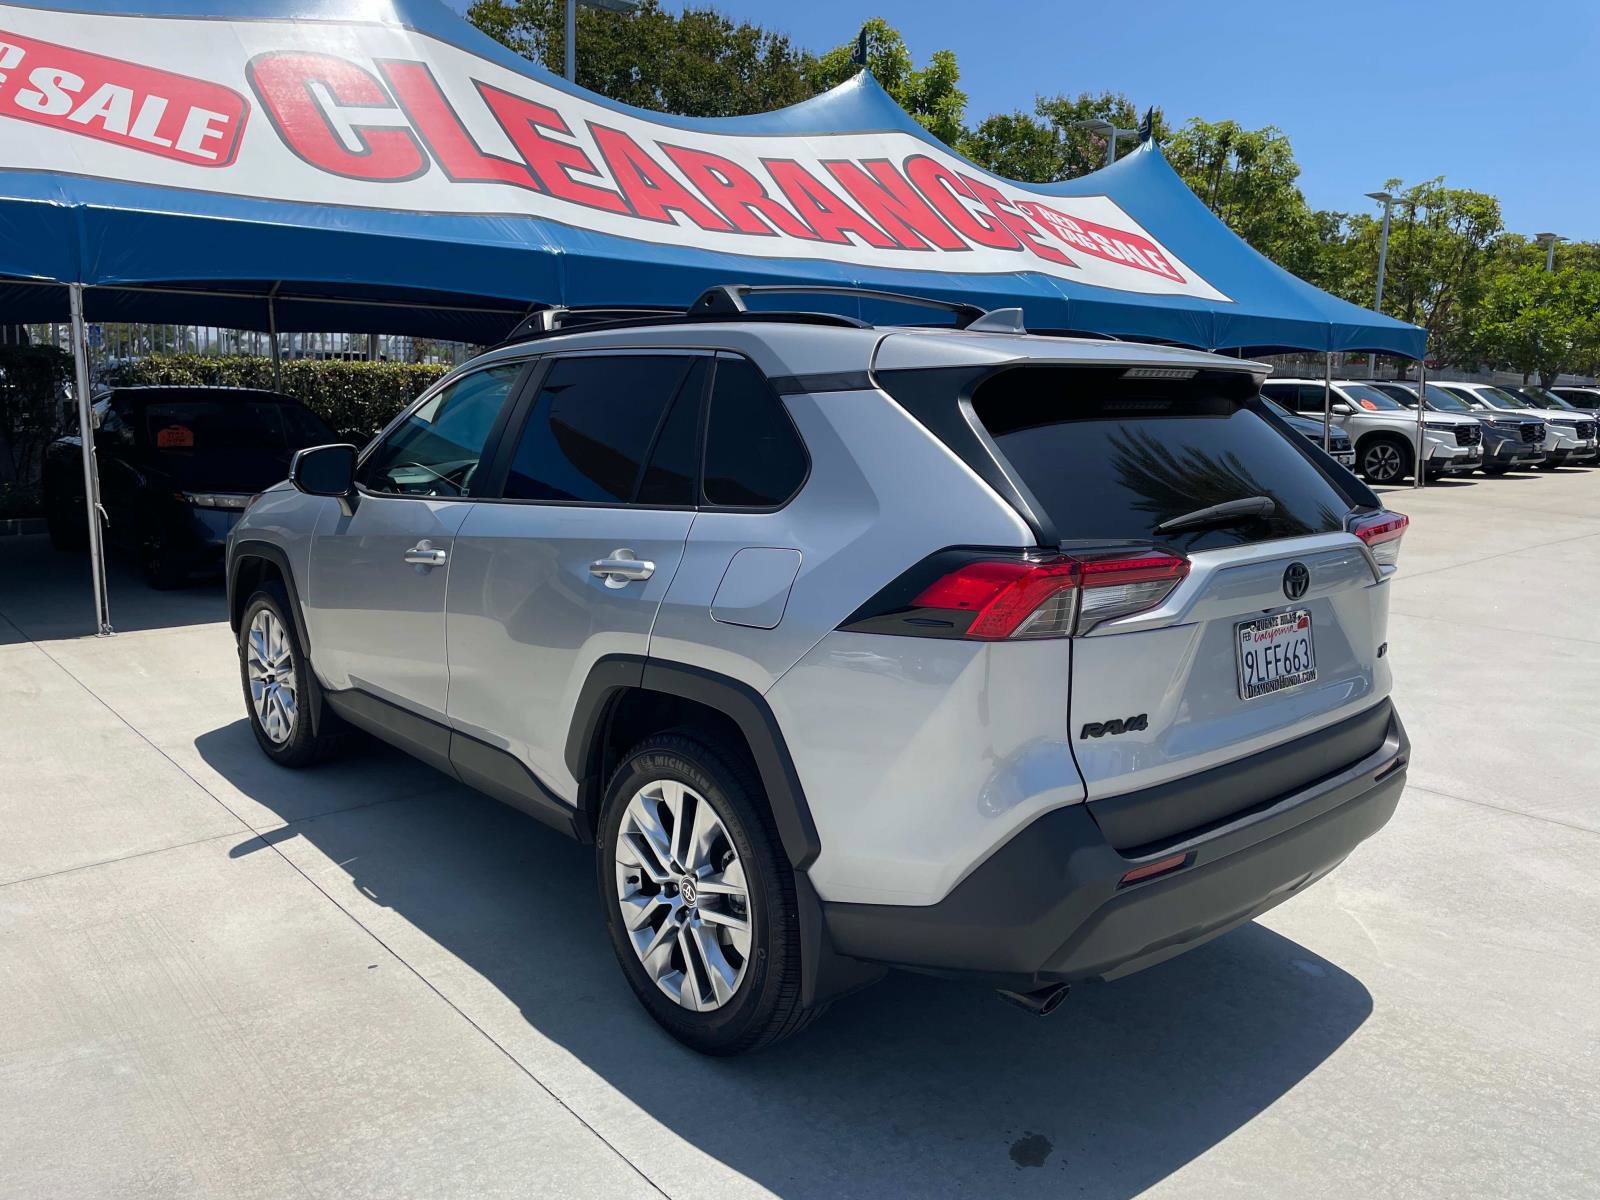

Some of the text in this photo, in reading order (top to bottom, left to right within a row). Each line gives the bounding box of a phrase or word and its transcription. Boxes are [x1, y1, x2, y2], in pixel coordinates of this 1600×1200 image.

[14, 67, 229, 161] SALE
[245, 50, 1082, 269] CLEARANCE
[1034, 205, 1083, 233] RED
[1050, 223, 1101, 251] TAG
[1088, 231, 1181, 280] SALE
[1242, 631, 1251, 642] FEB
[1254, 625, 1294, 644] California
[1245, 638, 1310, 684] 9LFF663
[1080, 714, 1148, 740] RAV4
[655, 755, 711, 790] MICHELIN
